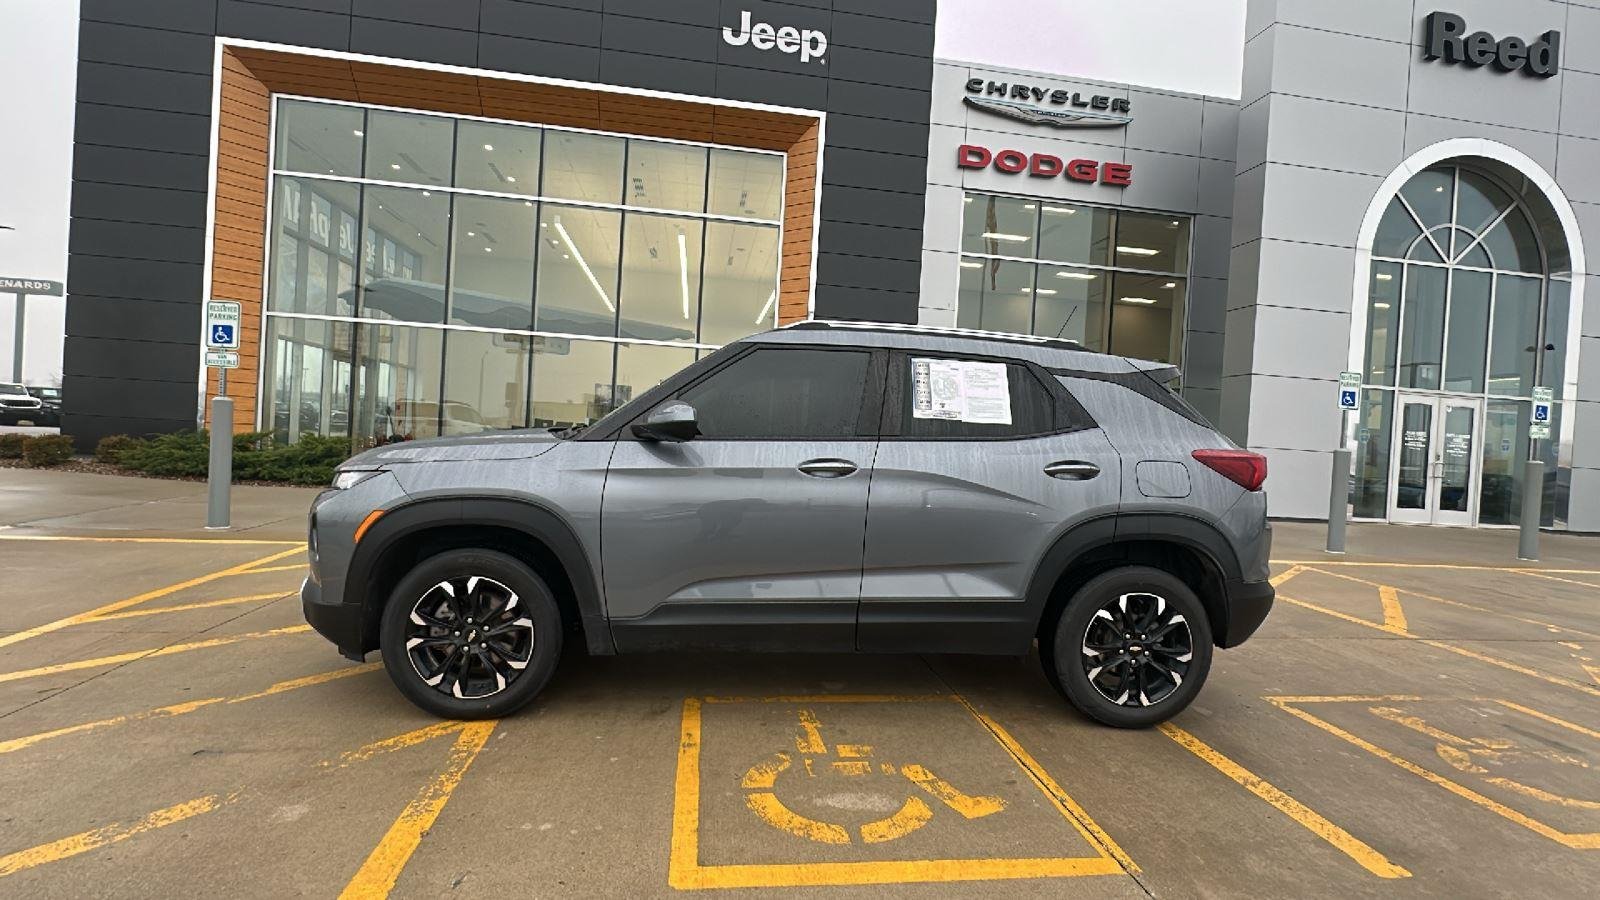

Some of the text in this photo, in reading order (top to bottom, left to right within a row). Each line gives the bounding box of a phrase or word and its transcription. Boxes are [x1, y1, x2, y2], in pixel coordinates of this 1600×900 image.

[722, 11, 827, 63] Jeep
[1425, 11, 1560, 78] Reed
[966, 78, 1131, 113] CHRYSLER
[958, 144, 1132, 187] DODGE
[210, 312, 238, 320] PARKING
